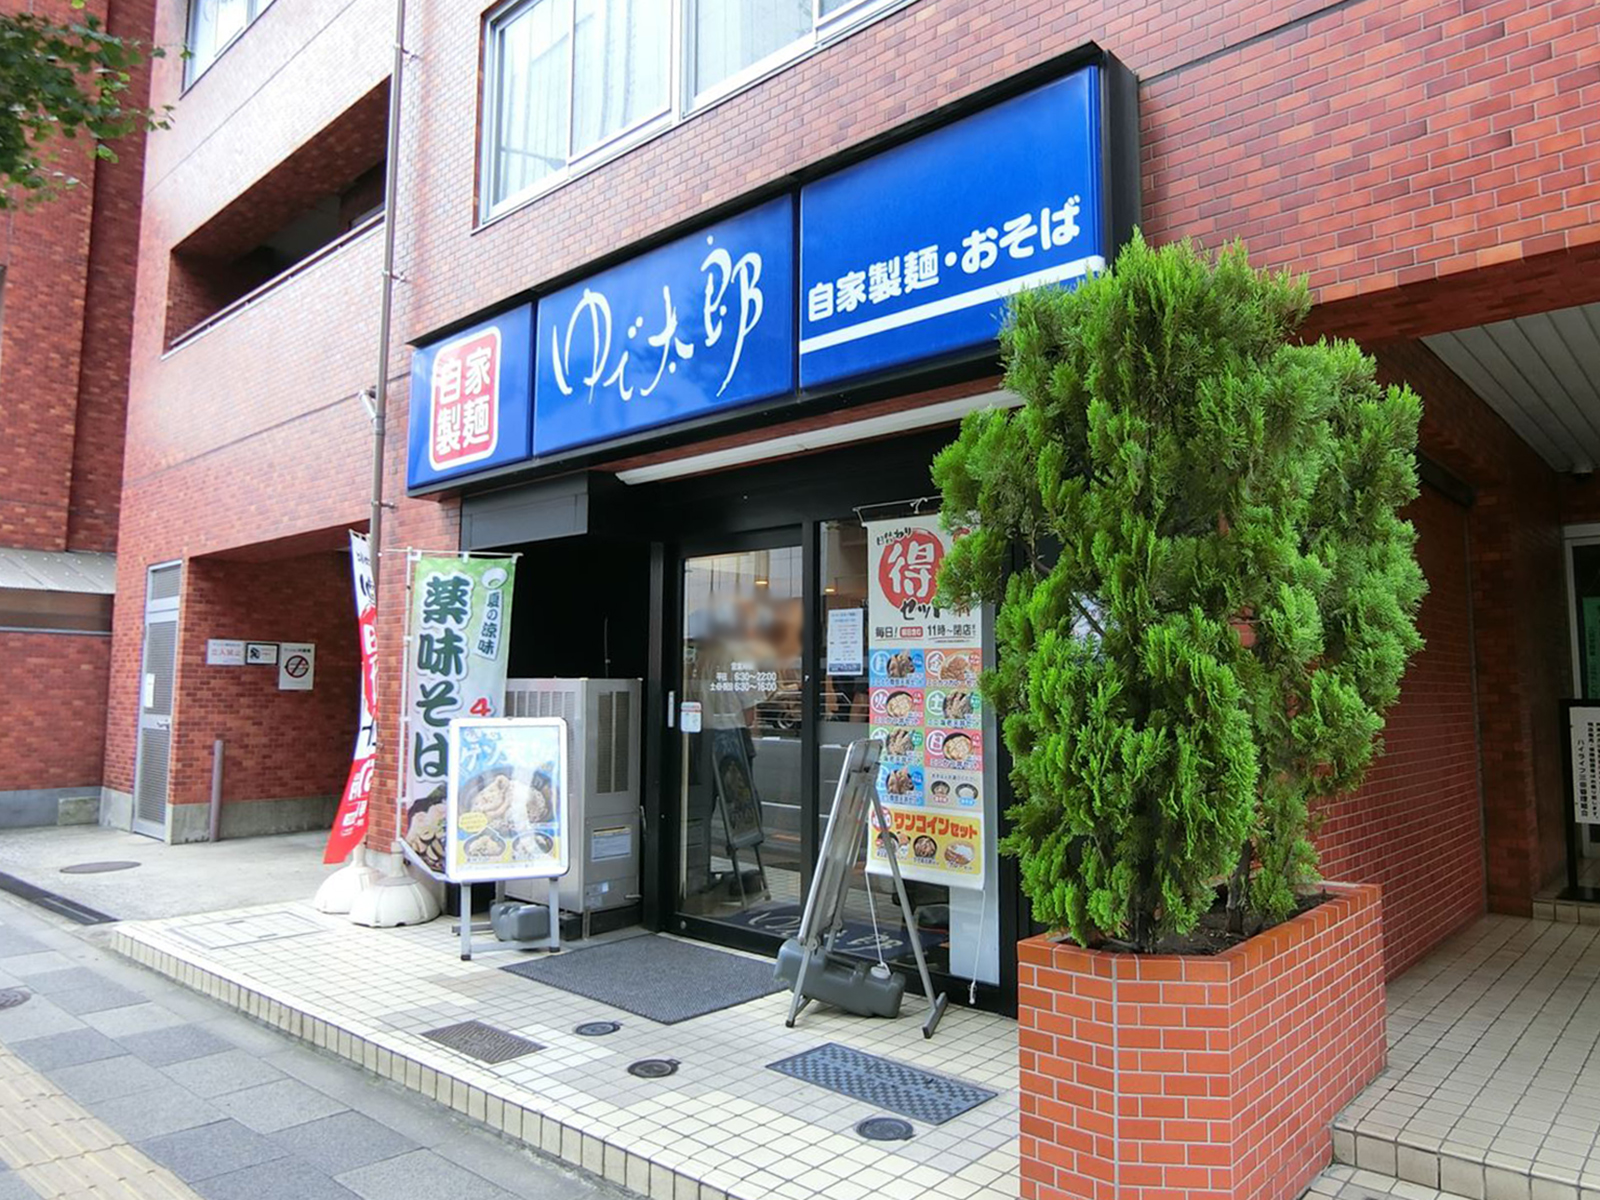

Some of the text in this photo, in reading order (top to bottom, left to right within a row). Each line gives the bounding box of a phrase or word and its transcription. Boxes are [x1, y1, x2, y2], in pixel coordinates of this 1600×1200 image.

[808, 194, 1081, 323] 自家製麺・おそば
[552, 235, 764, 404] ゆで太郎
[436, 346, 493, 405] 自家
[435, 394, 491, 455] 製麺
[887, 541, 935, 597] 得
[894, 811, 978, 839] ワンコインセット
